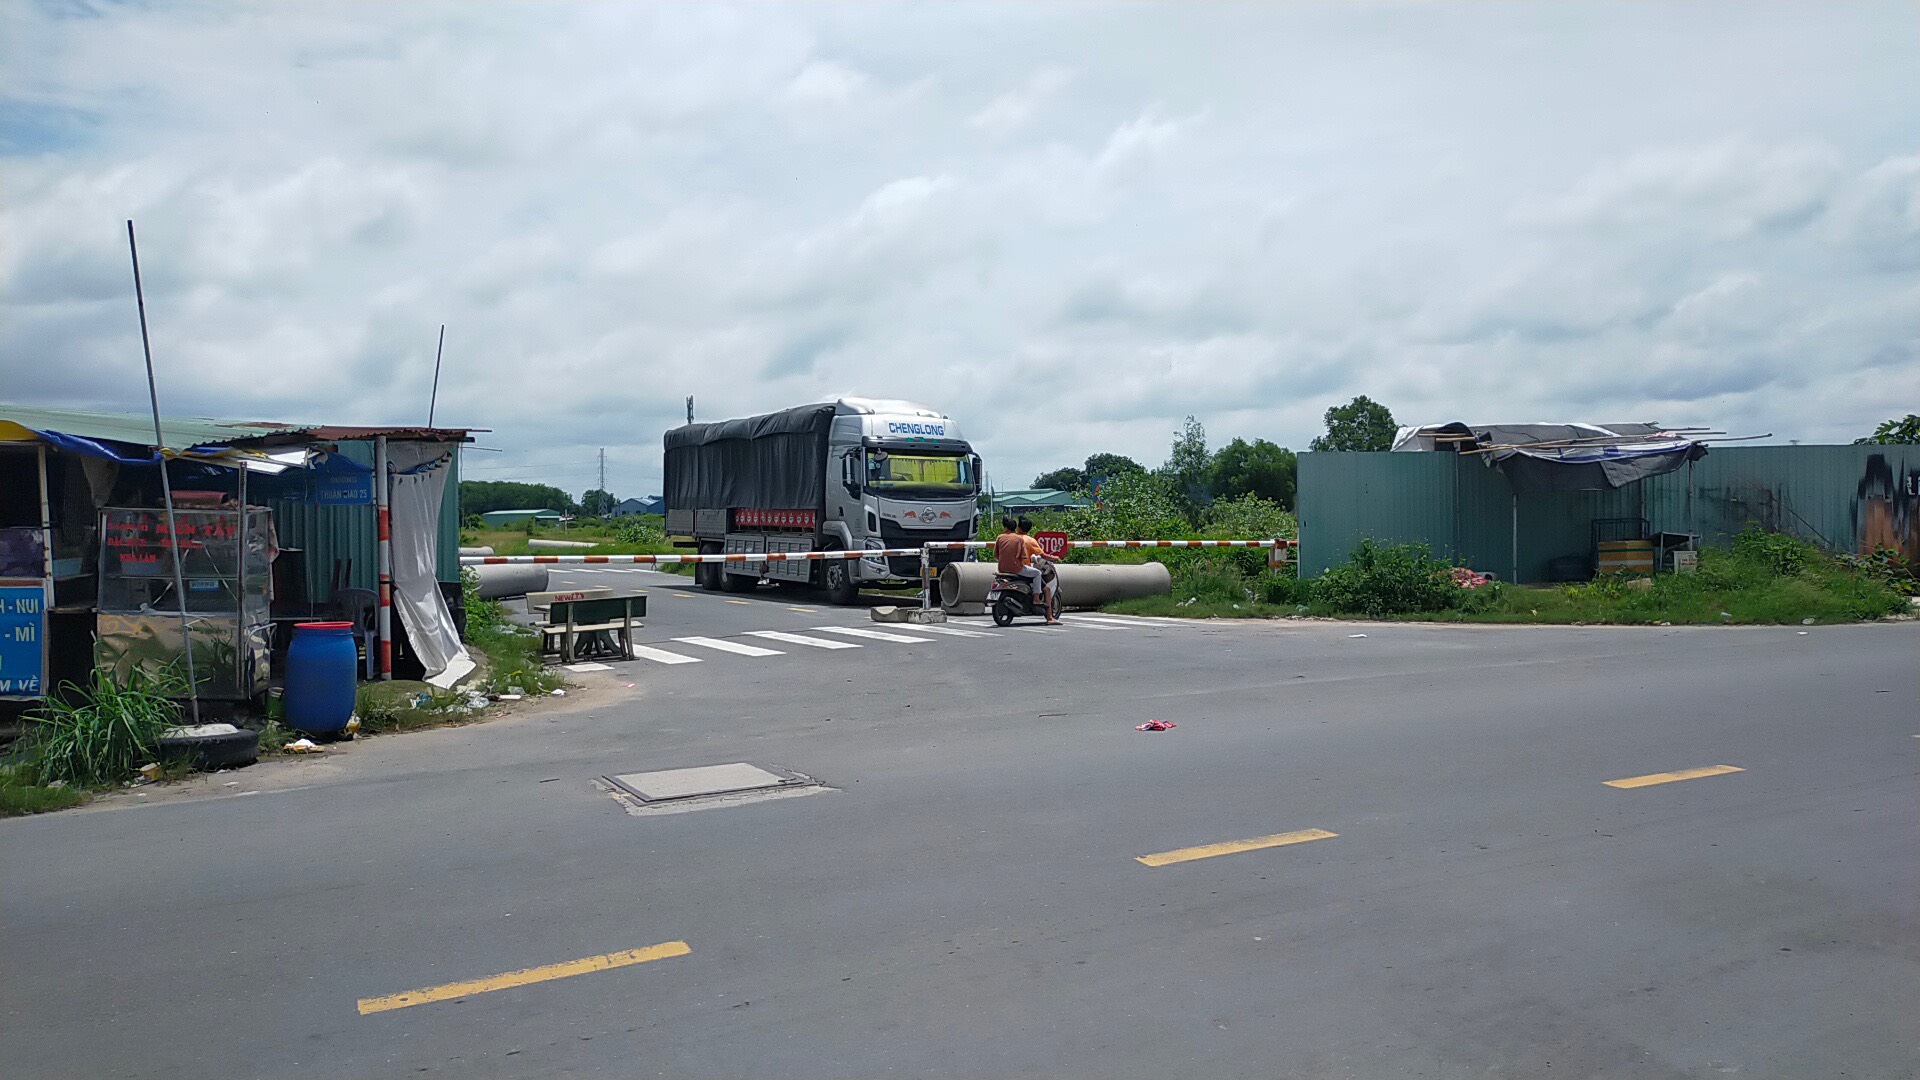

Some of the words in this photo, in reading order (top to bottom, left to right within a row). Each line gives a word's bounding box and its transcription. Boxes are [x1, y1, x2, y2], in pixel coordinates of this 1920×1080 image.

[888, 422, 945, 436] CHENGLONG
[360, 489, 368, 499] 25
[1037, 537, 1064, 553] STOP
[16, 598, 39, 614] NUI
[15, 621, 36, 642] MÌ
[18, 674, 39, 692] VỀ
